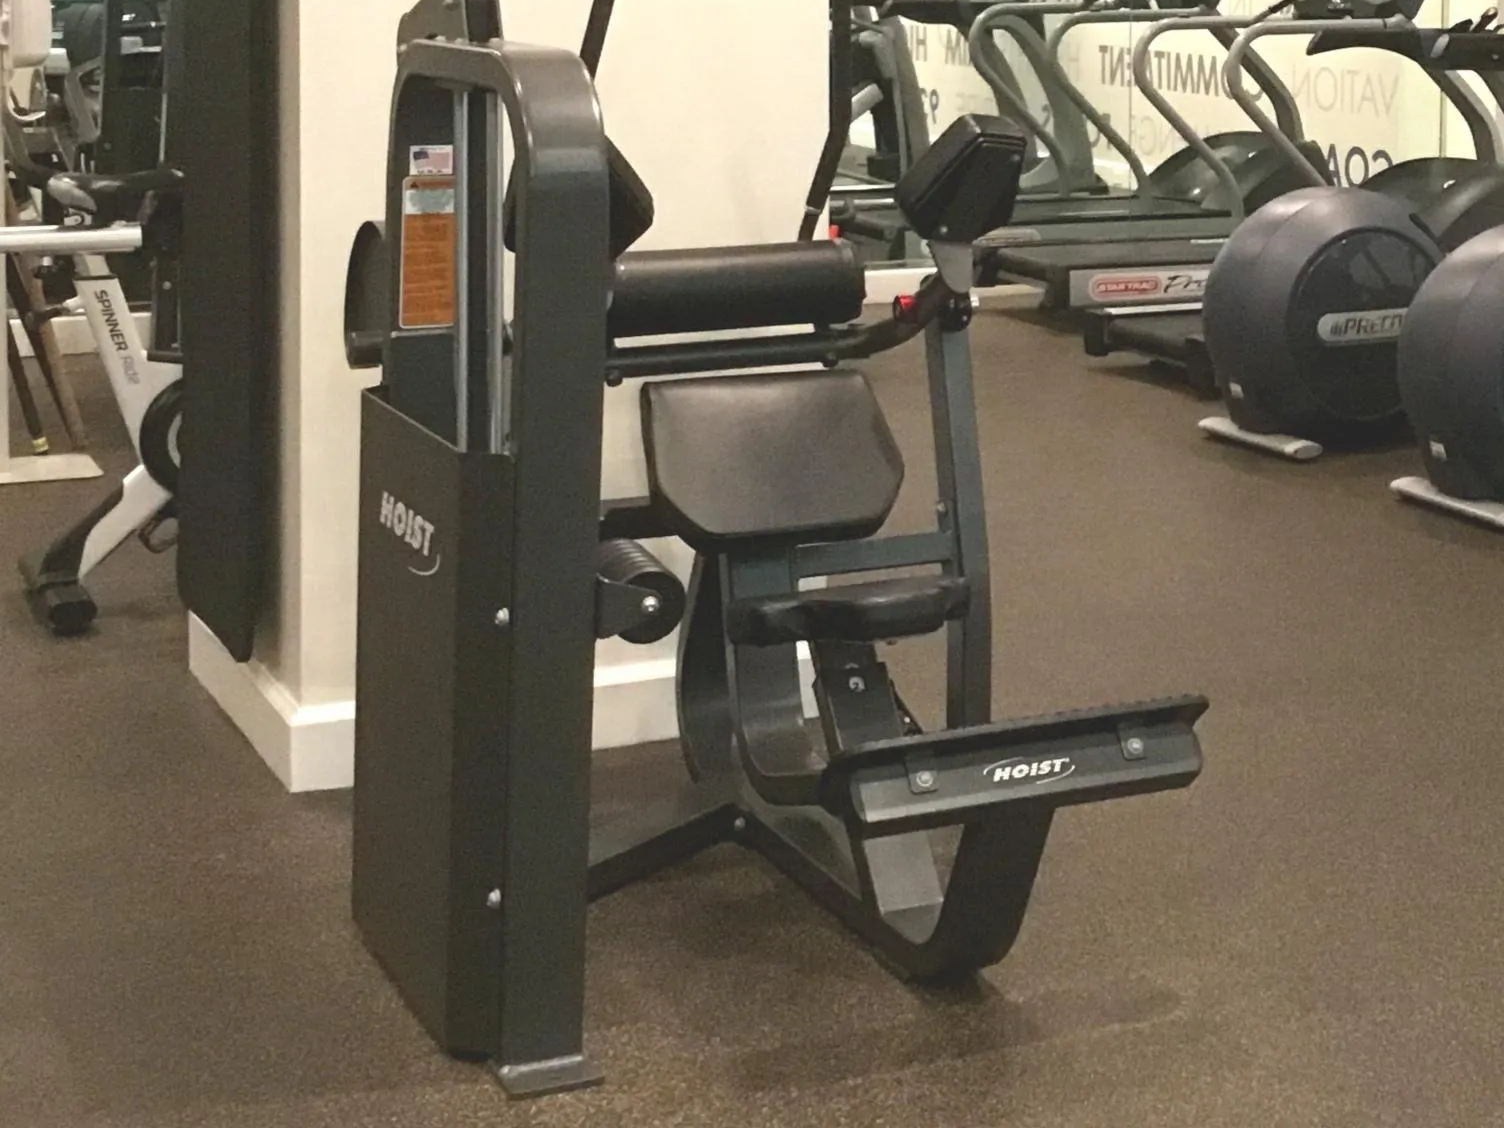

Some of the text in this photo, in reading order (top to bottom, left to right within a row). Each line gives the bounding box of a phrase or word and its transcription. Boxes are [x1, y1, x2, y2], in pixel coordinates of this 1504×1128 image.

[94, 288, 129, 352] SPINNER
[379, 490, 435, 556] HOIST
[992, 757, 1069, 783] HOIST
